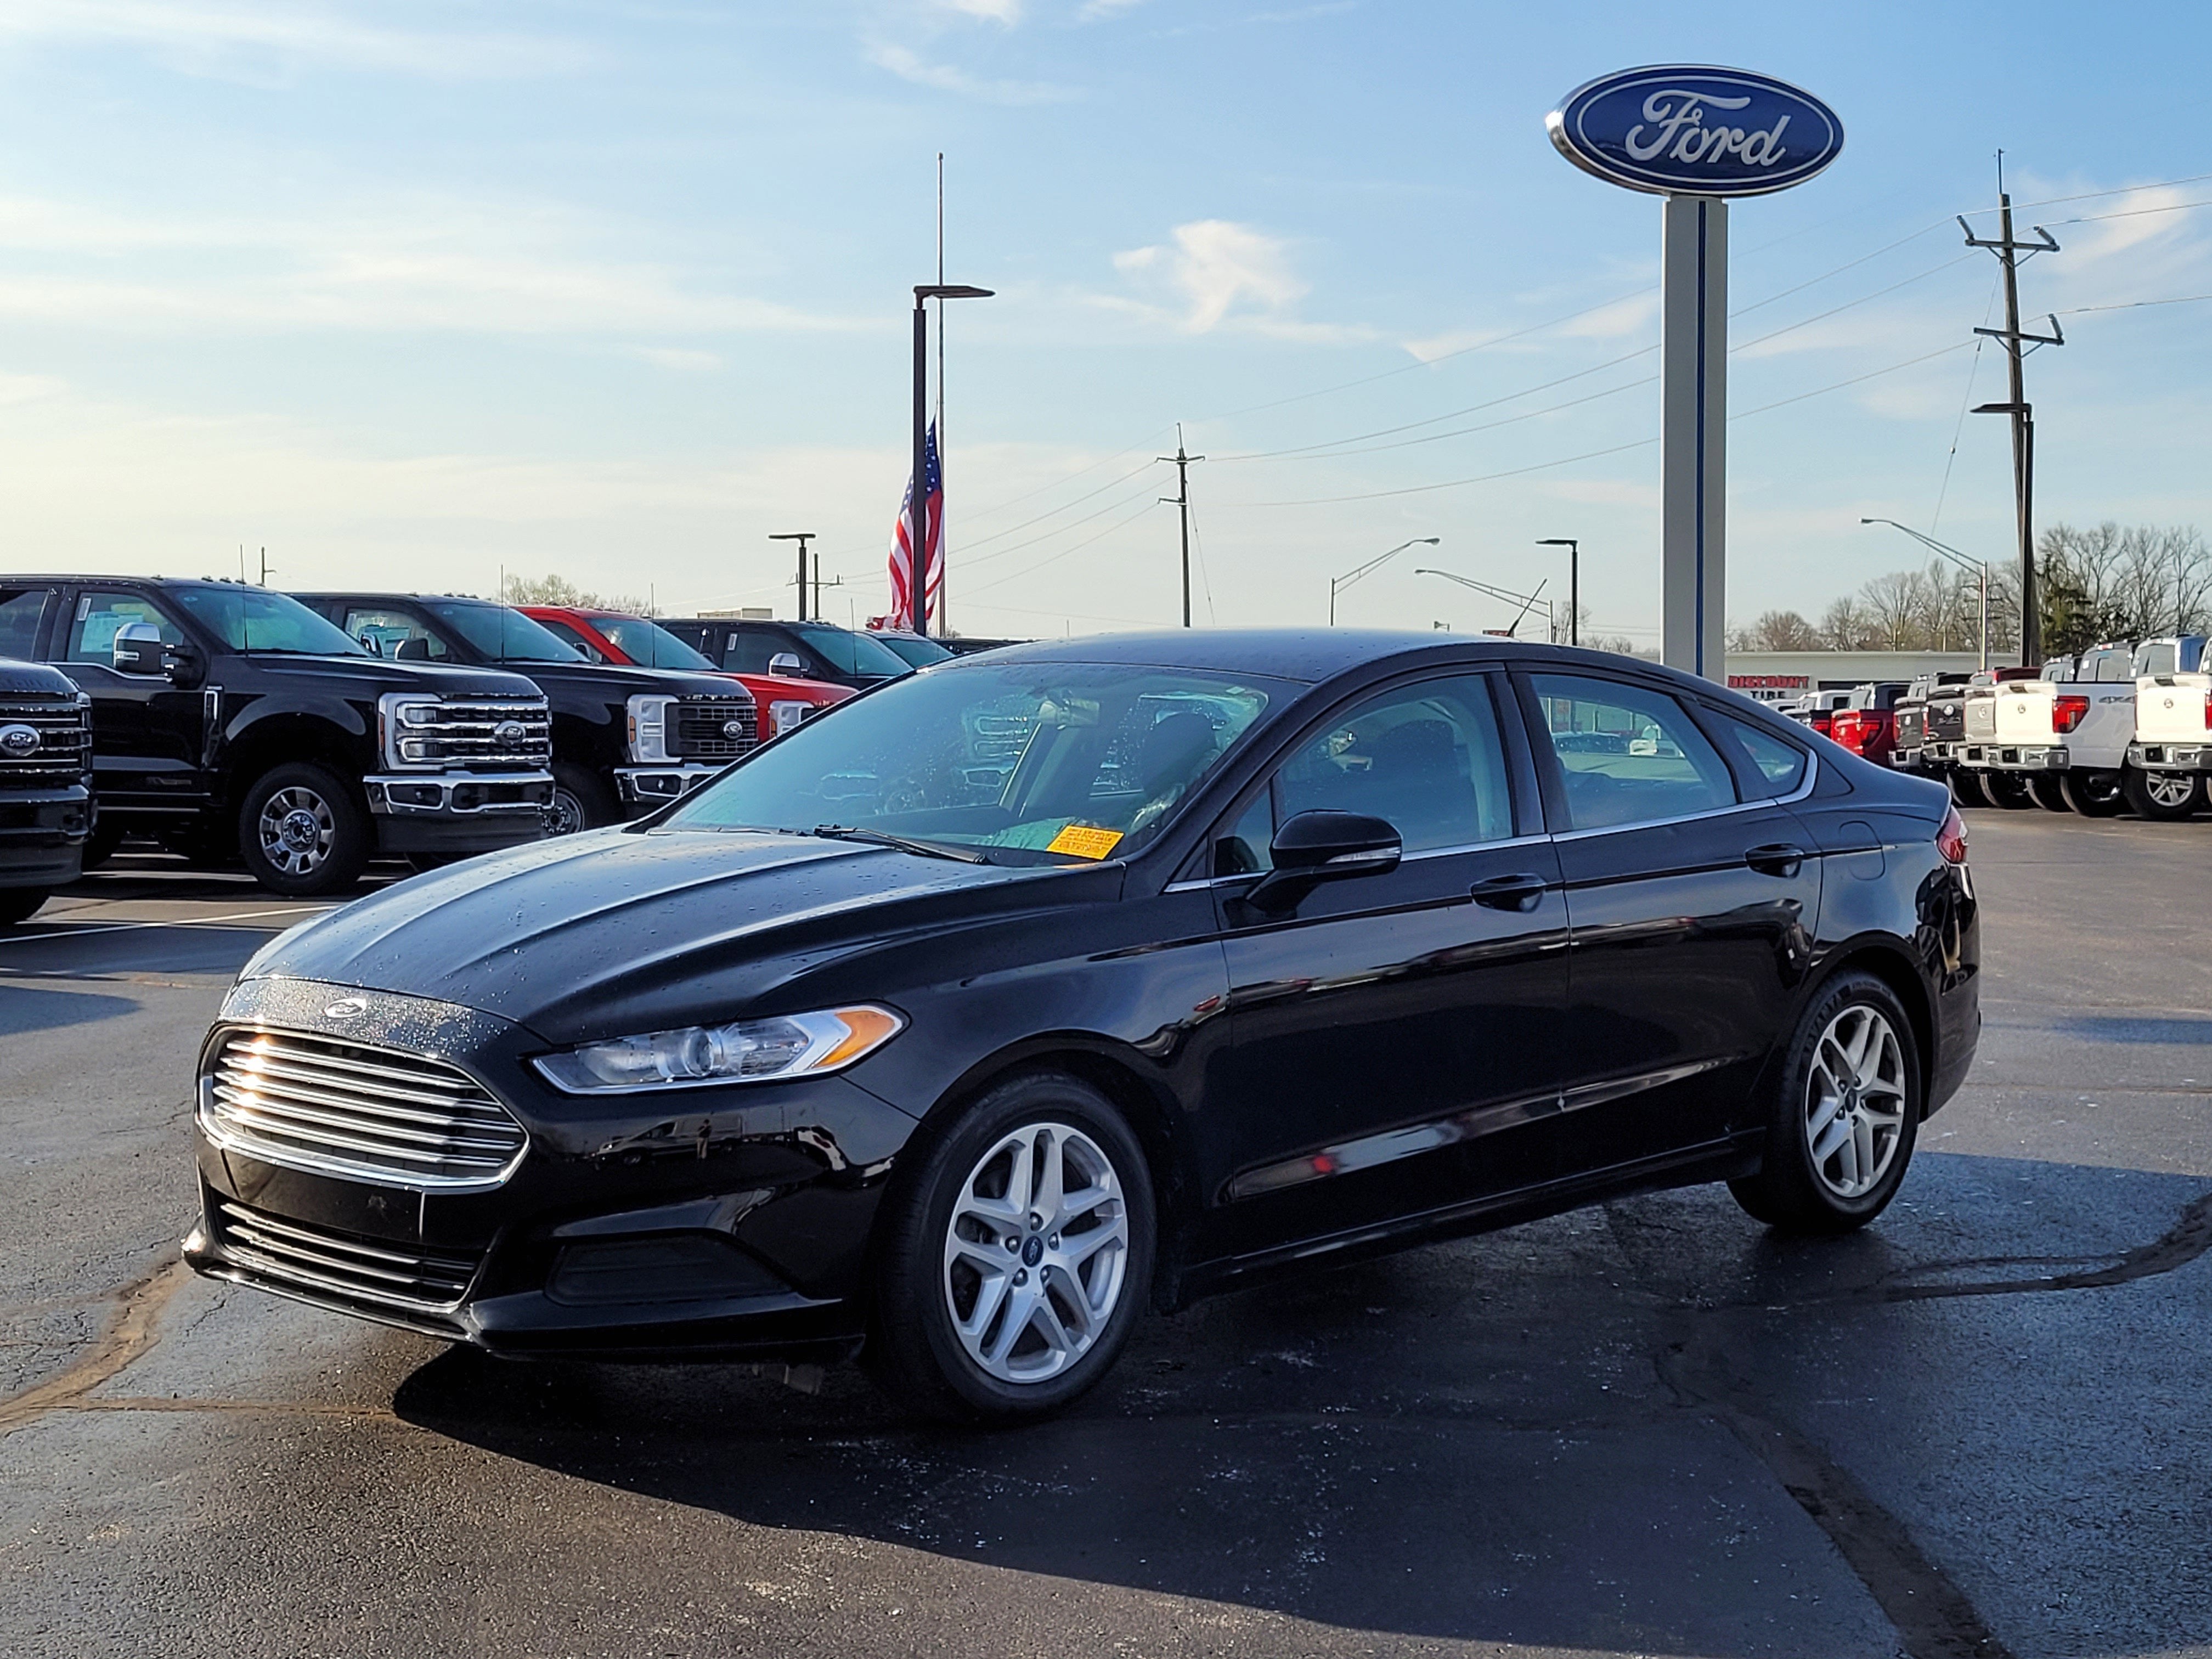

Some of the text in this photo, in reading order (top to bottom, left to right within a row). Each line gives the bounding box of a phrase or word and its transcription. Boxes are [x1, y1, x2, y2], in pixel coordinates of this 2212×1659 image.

[1625, 89, 1791, 166] Ford
[1728, 675, 1809, 689] DISCOUNT
[1750, 690, 1786, 701] TIRE
